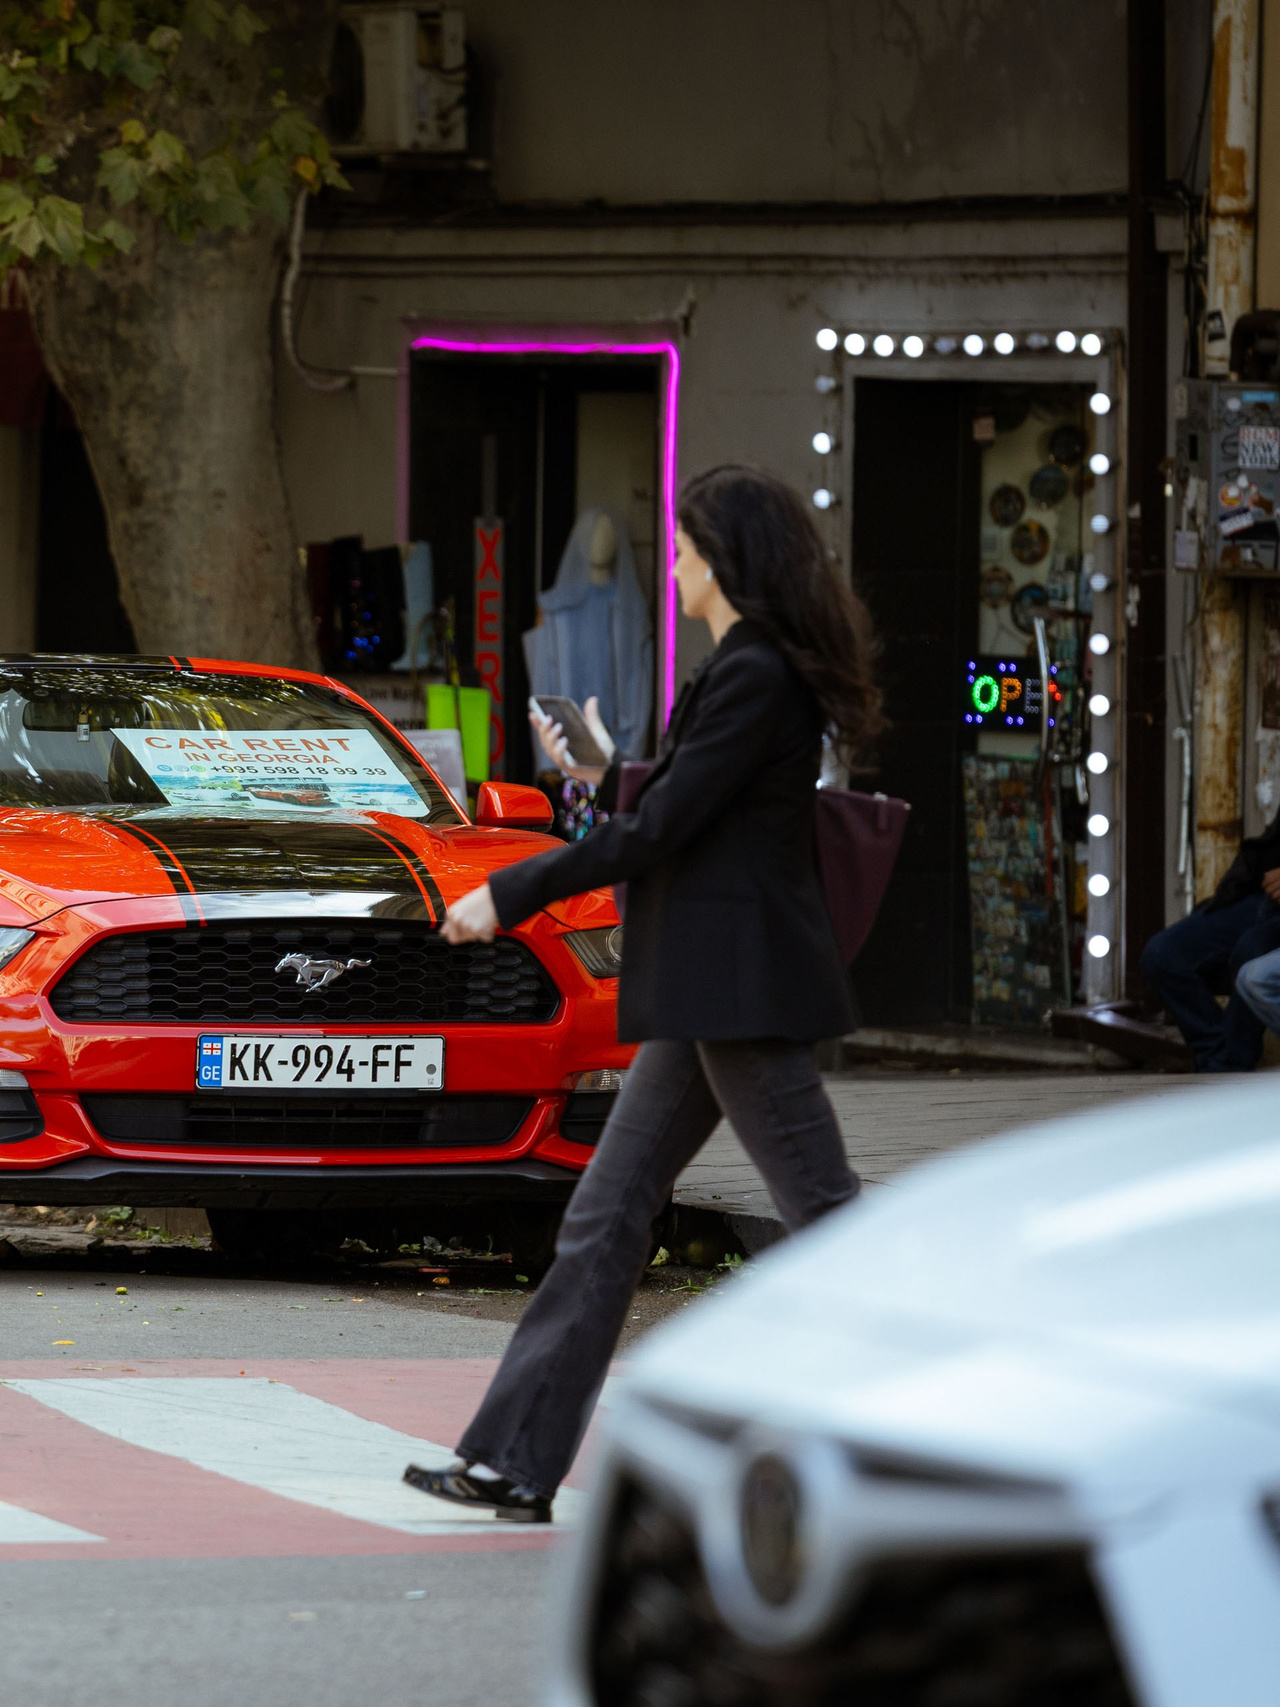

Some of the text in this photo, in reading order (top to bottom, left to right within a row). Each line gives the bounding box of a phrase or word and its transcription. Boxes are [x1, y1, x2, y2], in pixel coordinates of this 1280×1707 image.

[972, 675, 1062, 715] OPE
[144, 736, 351, 752] CAR RENT
[184, 752, 342, 764] IN GEORGIA
[210, 765, 388, 776] +995 598 18 99 39
[201, 1043, 415, 1083] GE KK-994-FF
